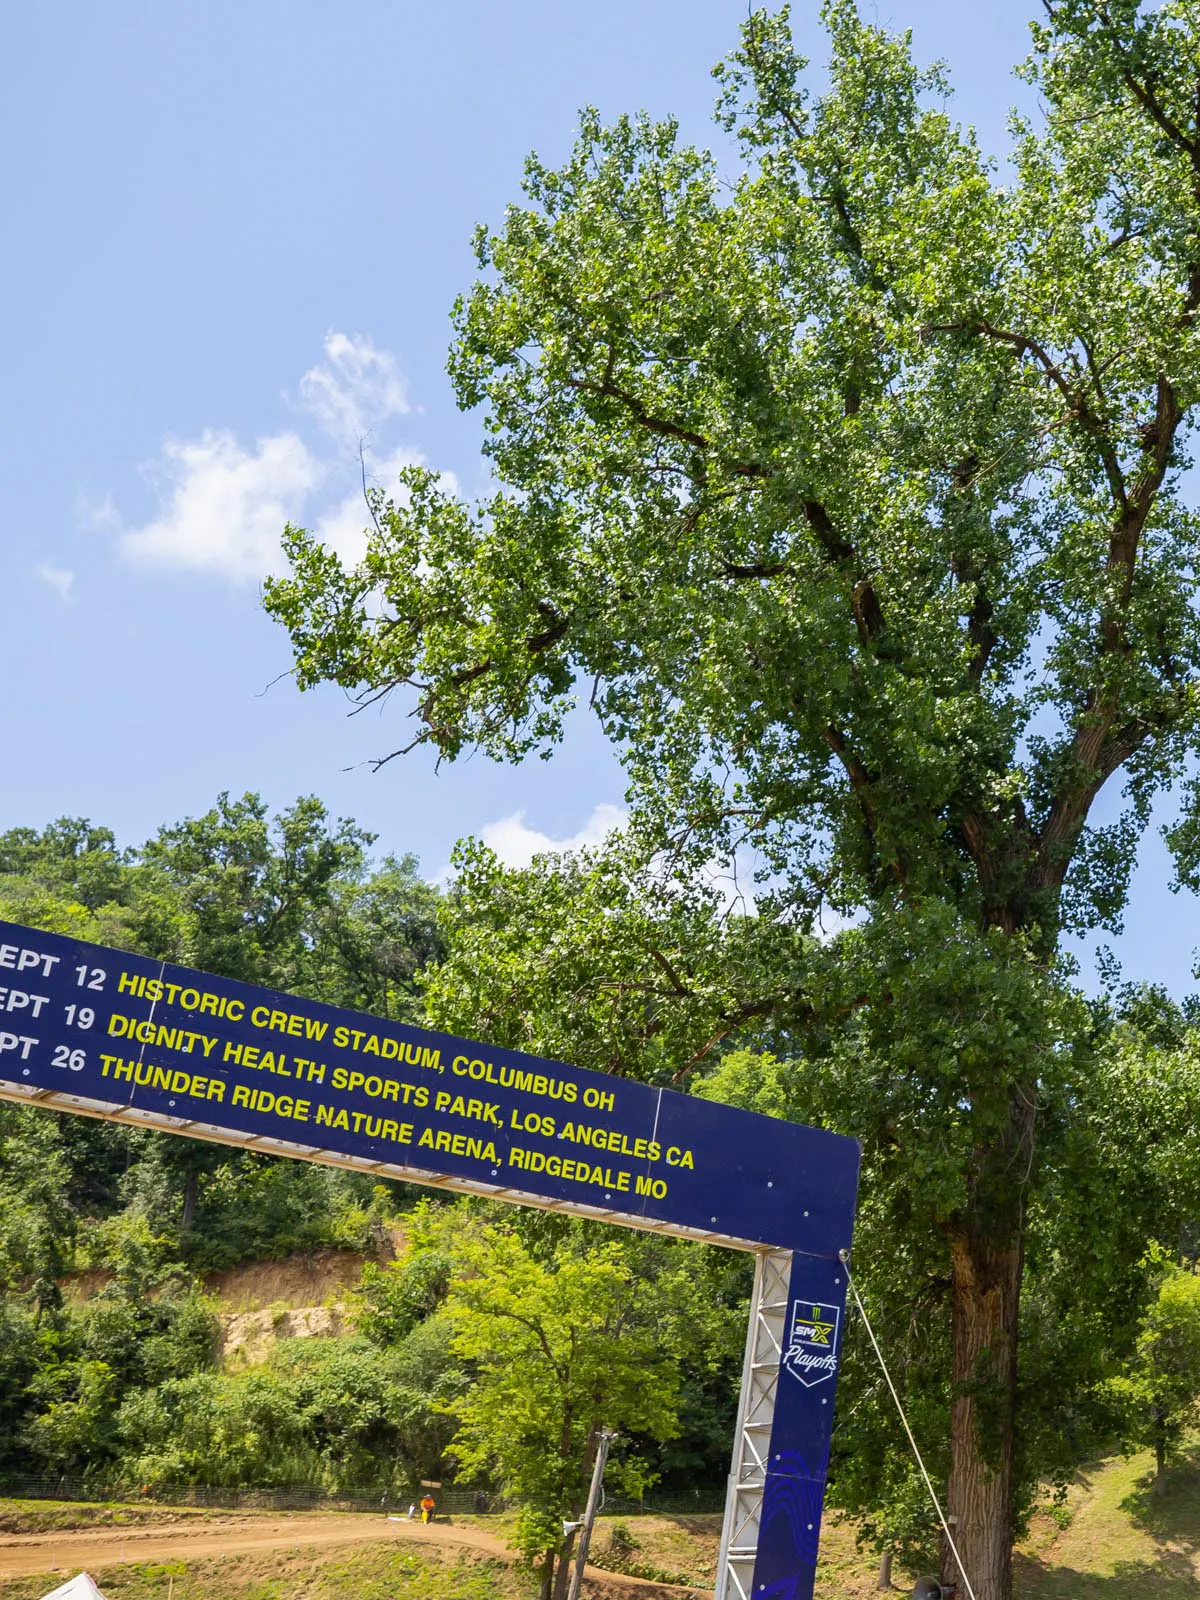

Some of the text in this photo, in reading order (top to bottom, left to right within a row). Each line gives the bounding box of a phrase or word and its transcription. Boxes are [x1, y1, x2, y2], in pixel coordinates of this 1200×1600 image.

[64, 1004, 95, 1030] 19
[108, 1014, 217, 1057] DIGNITY
[224, 1042, 326, 1082] HEALTH
[332, 1068, 429, 1108] SPORTS
[435, 1091, 504, 1129] PARK,
[511, 1110, 556, 1137] LOS
[561, 1122, 660, 1161] ANGELES
[666, 1147, 694, 1169] CA
[75, 965, 107, 991] 12
[118, 973, 244, 1021] HISTORIC
[252, 1007, 328, 1041] CREW
[333, 1027, 445, 1074] STADIUM,
[453, 1056, 577, 1103] COLUMBUS
[583, 1088, 615, 1112] OH
[51, 1045, 87, 1072] 26
[100, 1055, 225, 1102] THUNDER
[232, 1085, 310, 1121] RIDGE
[316, 1105, 413, 1145] NATURE
[419, 1128, 502, 1167] ARENA,
[509, 1148, 630, 1192] RIDGEDALE
[635, 1176, 668, 1199] MO
[782, 1345, 837, 1373] Playoffs
[795, 1325, 832, 1344] SMX
